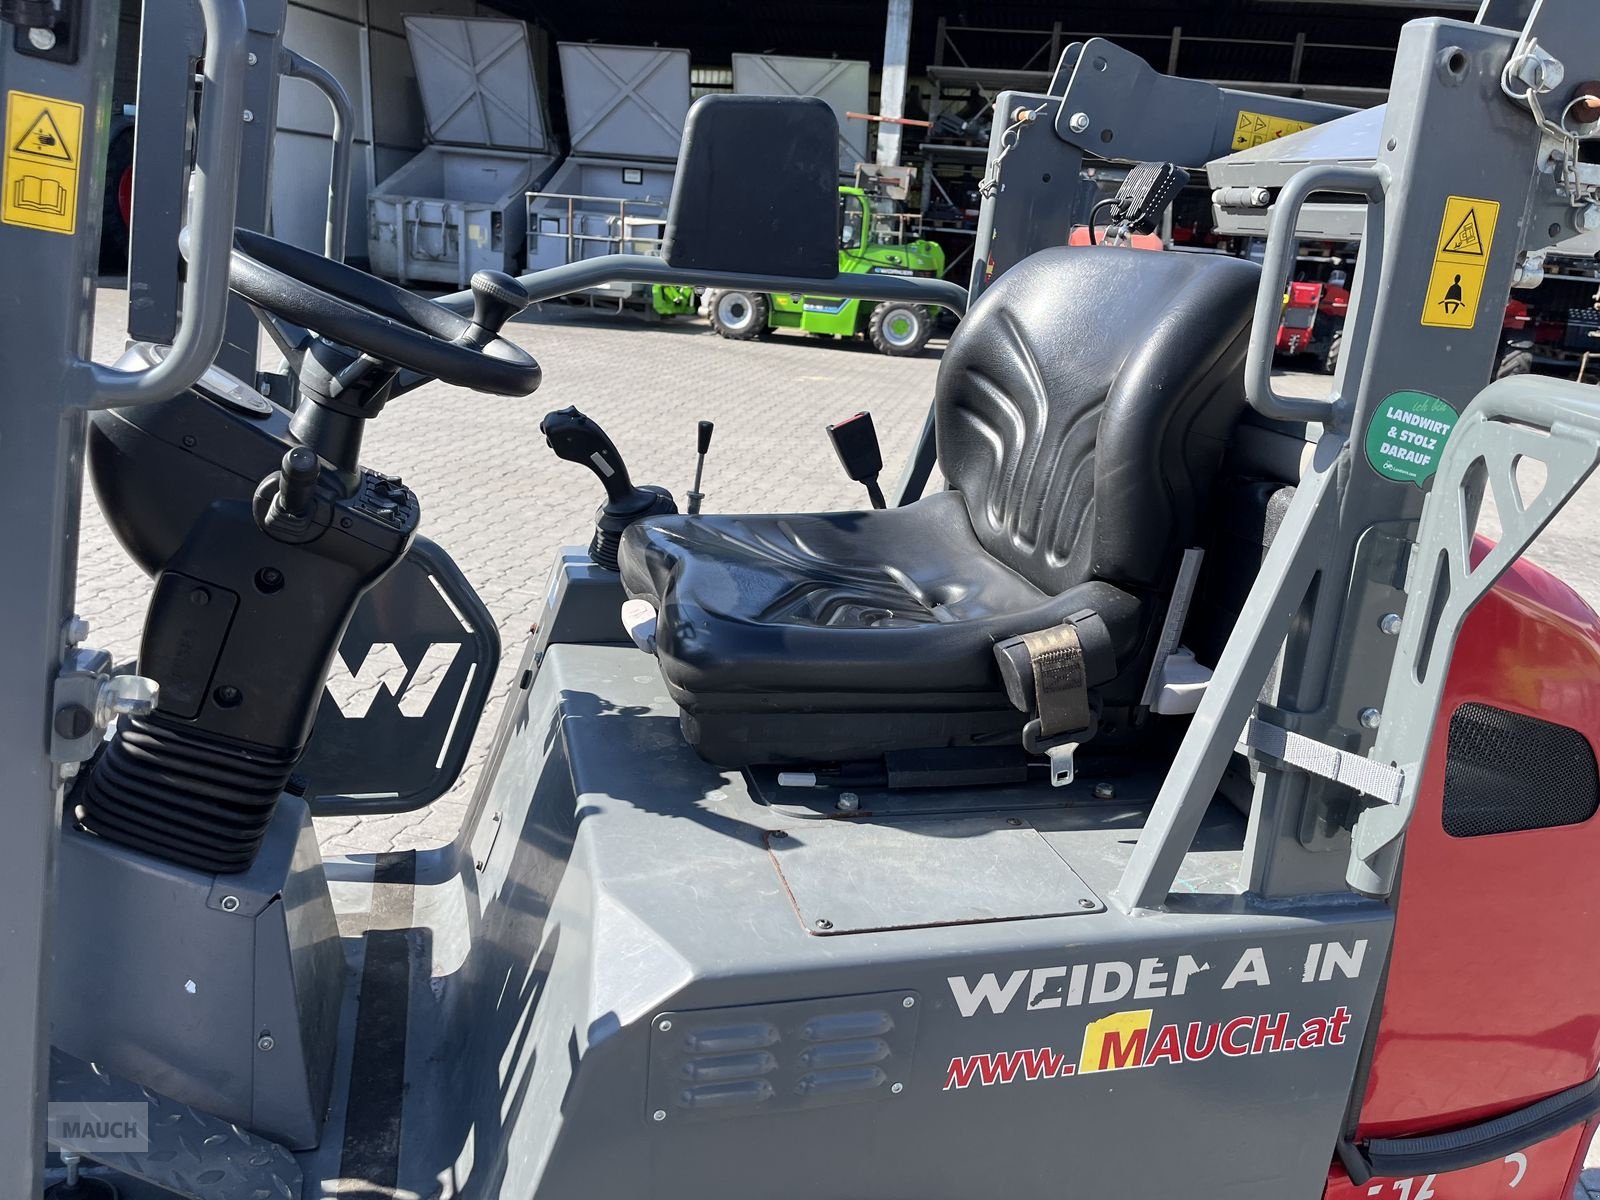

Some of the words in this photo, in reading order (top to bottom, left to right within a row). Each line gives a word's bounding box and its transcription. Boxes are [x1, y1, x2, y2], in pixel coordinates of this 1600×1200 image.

[1386, 407, 1451, 435] LANDWIRT
[1387, 426, 1398, 438] &
[1399, 429, 1438, 450] STOLZ
[1379, 442, 1432, 466] DARAUF
